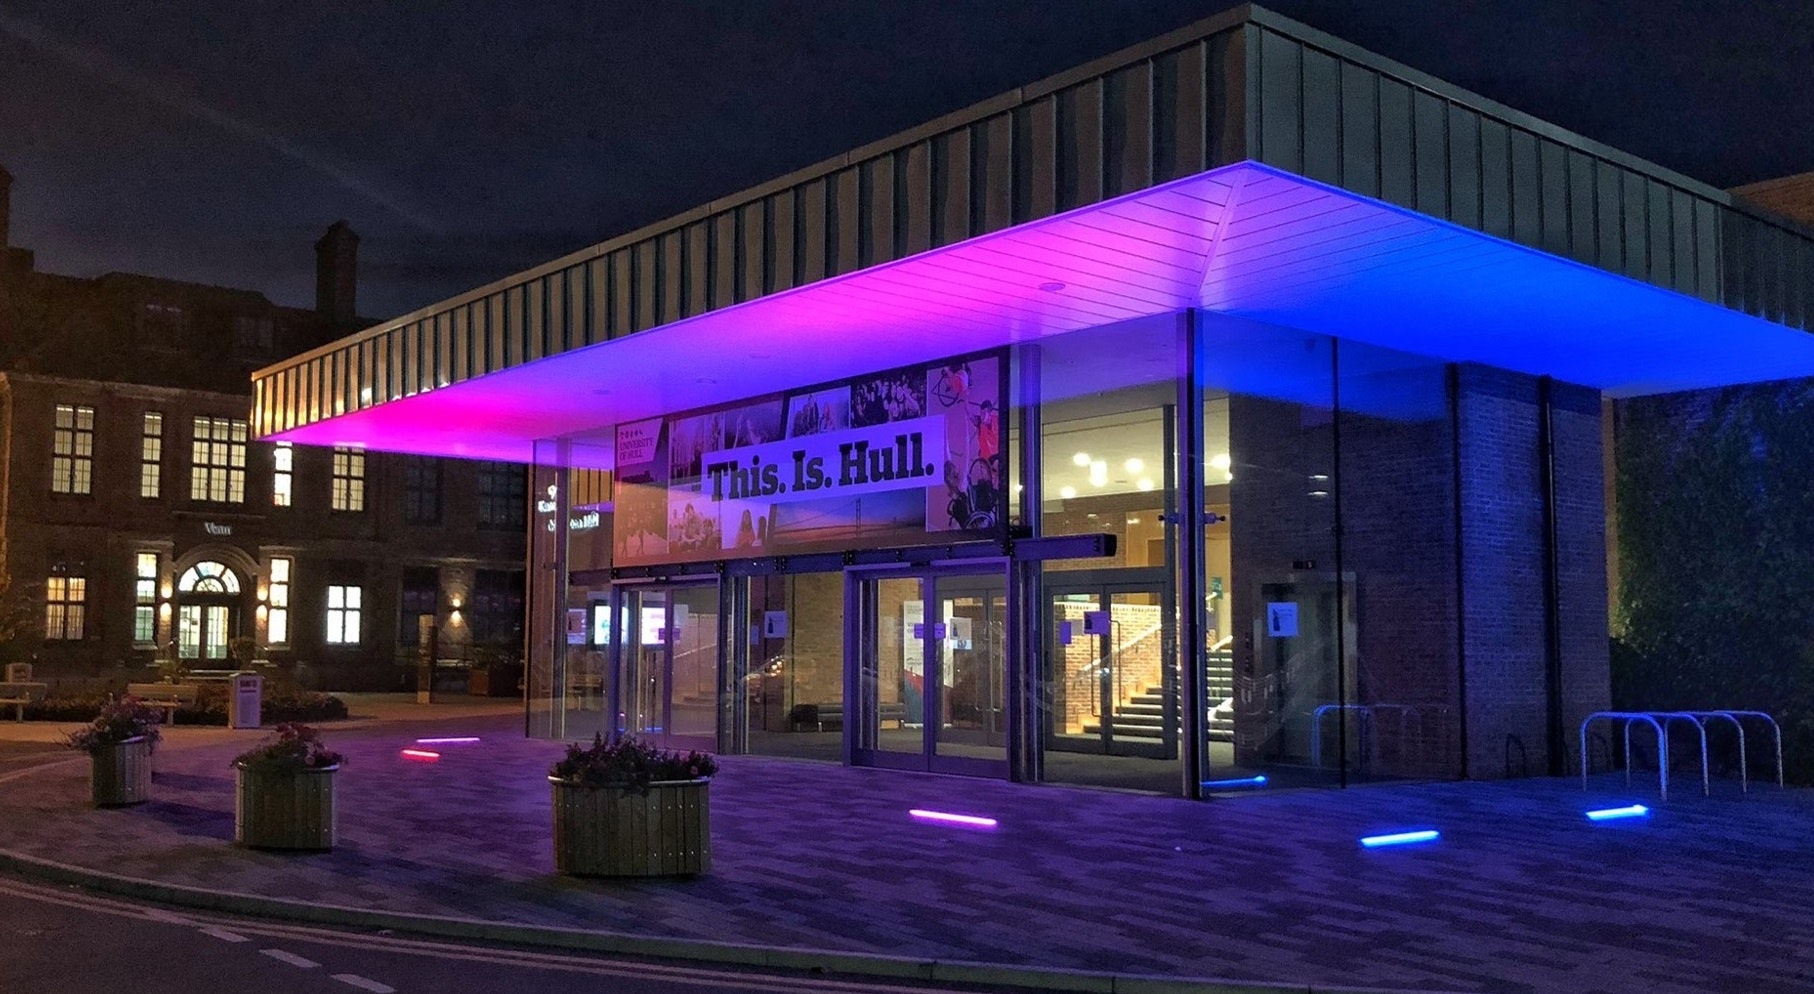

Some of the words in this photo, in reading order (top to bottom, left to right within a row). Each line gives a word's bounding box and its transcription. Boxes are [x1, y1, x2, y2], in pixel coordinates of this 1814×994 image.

[620, 438, 653, 451] UNIVERSITY
[620, 452, 627, 461] OF
[628, 449, 643, 460] HULL
[708, 454, 786, 501] This.
[792, 449, 832, 492] Is.
[838, 432, 935, 486] Hull.
